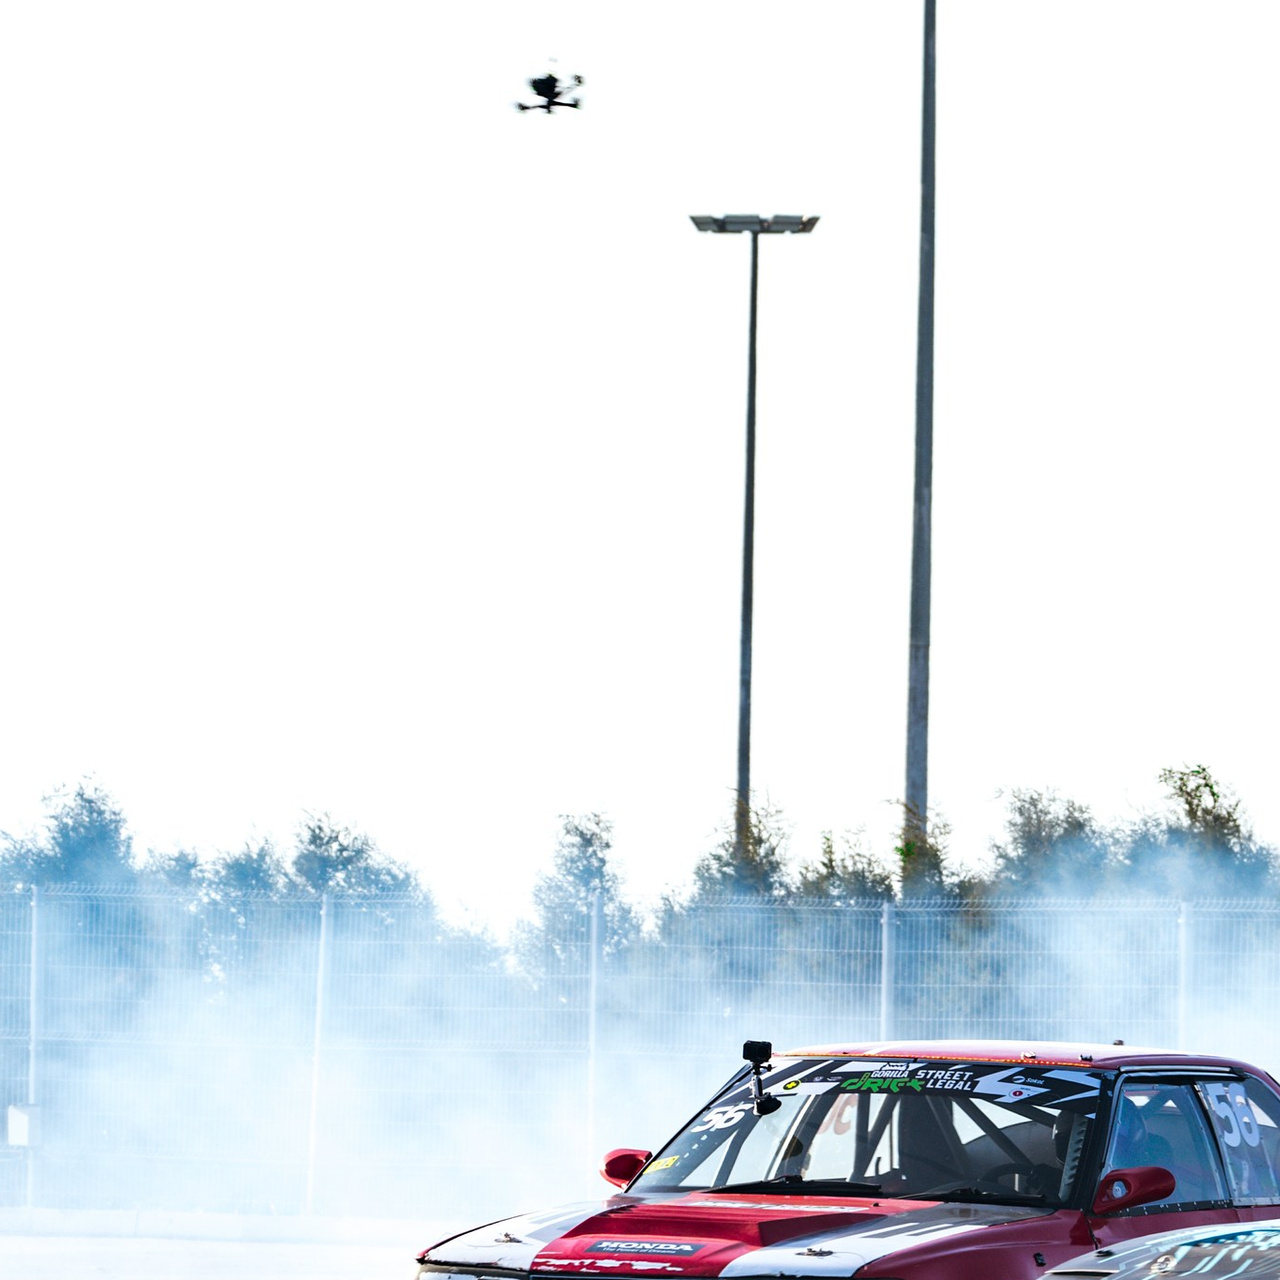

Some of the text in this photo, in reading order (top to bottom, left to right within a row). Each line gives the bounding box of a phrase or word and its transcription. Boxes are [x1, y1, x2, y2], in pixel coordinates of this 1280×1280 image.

[871, 1069, 909, 1078] GORILLA
[915, 1069, 973, 1081] STREET
[926, 1079, 972, 1091] LEGAL
[690, 1103, 755, 1133] 56
[597, 1241, 694, 1251] HONDA
